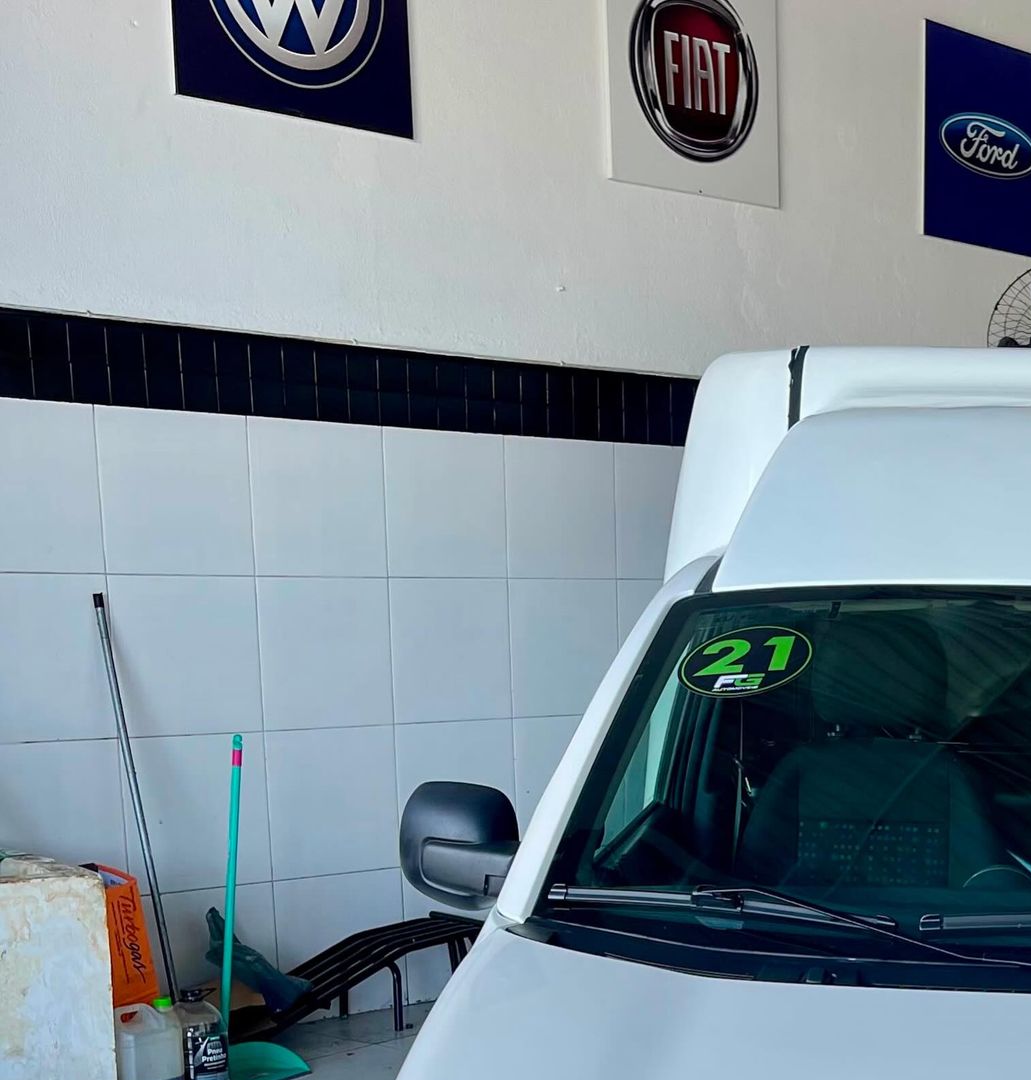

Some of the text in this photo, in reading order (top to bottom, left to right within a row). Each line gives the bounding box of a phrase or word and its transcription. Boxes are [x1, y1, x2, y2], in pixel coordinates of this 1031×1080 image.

[663, 30, 731, 116] FIAT
[960, 121, 1021, 171] Ford
[692, 635, 796, 677] 21
[713, 673, 766, 688] FG
[207, 1047, 223, 1056] Pneu
